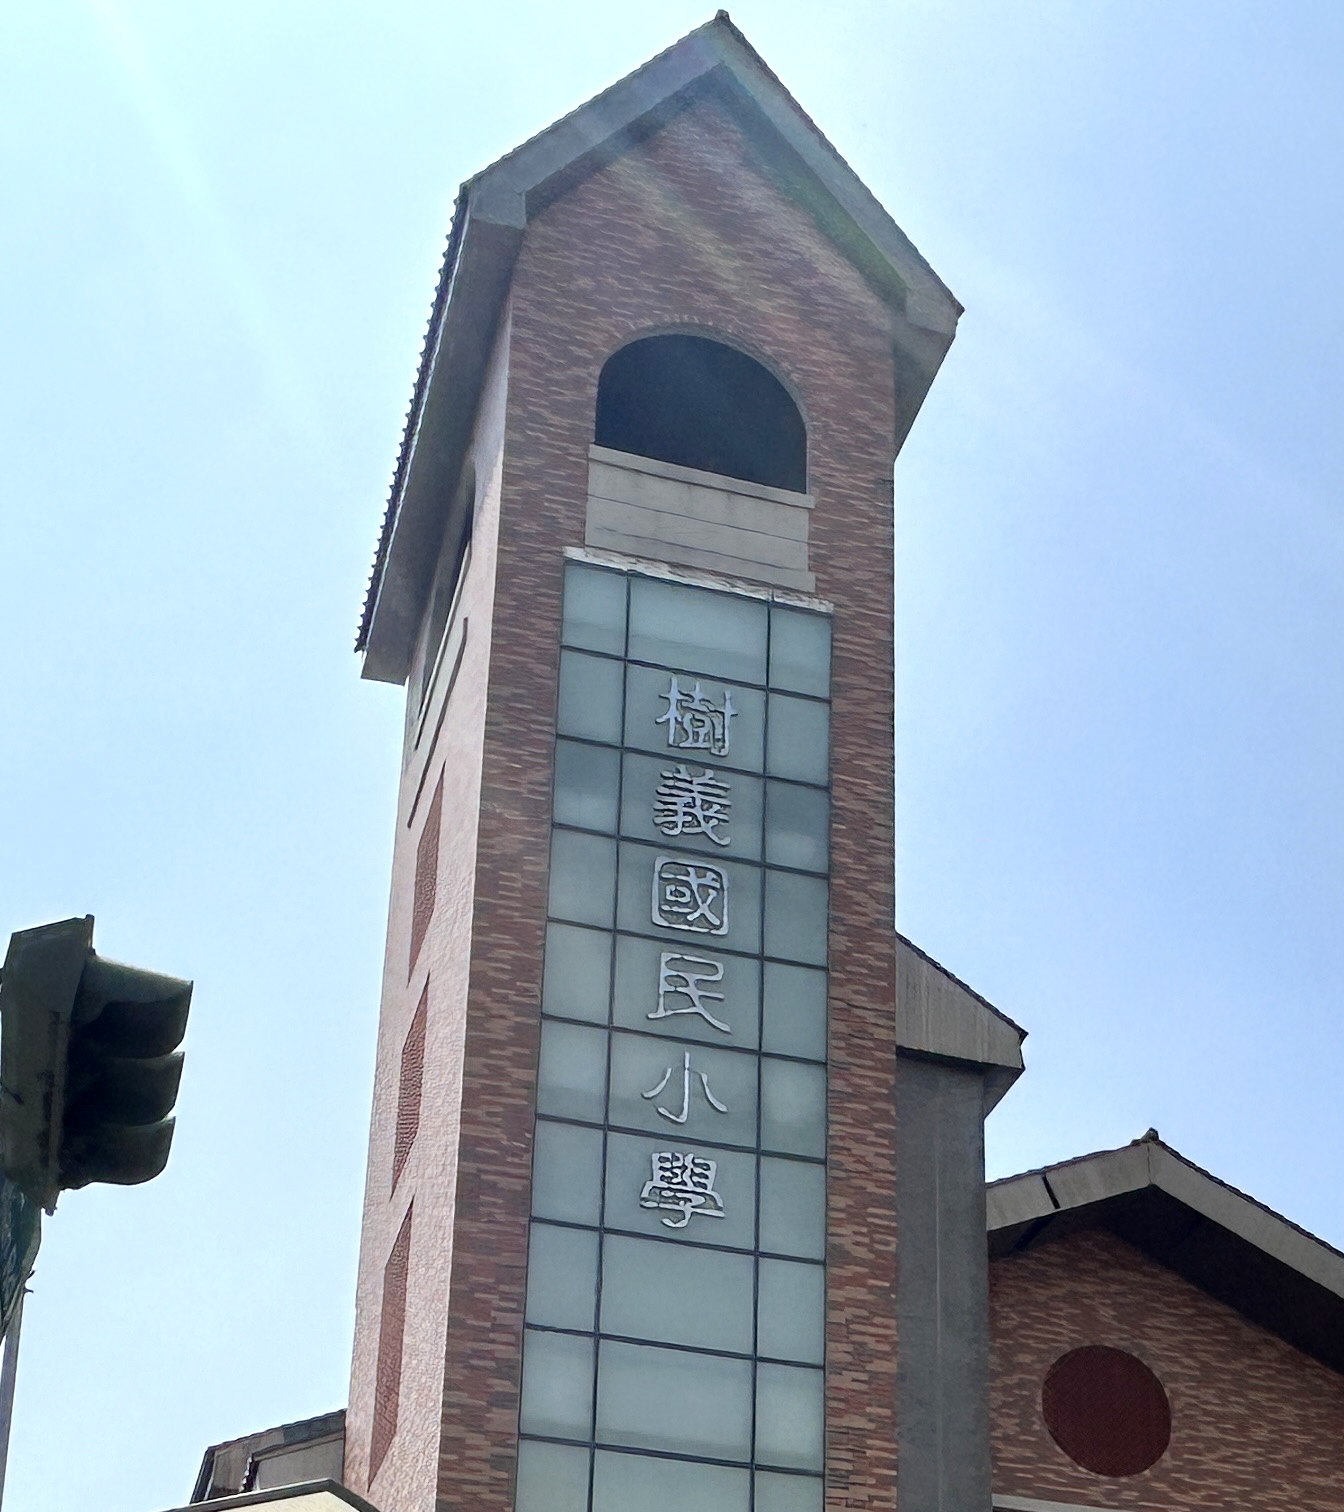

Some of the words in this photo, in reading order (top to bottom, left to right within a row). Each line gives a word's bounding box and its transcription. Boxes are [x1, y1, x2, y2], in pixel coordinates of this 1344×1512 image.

[640, 676, 737, 1229] 樹義國民小學
